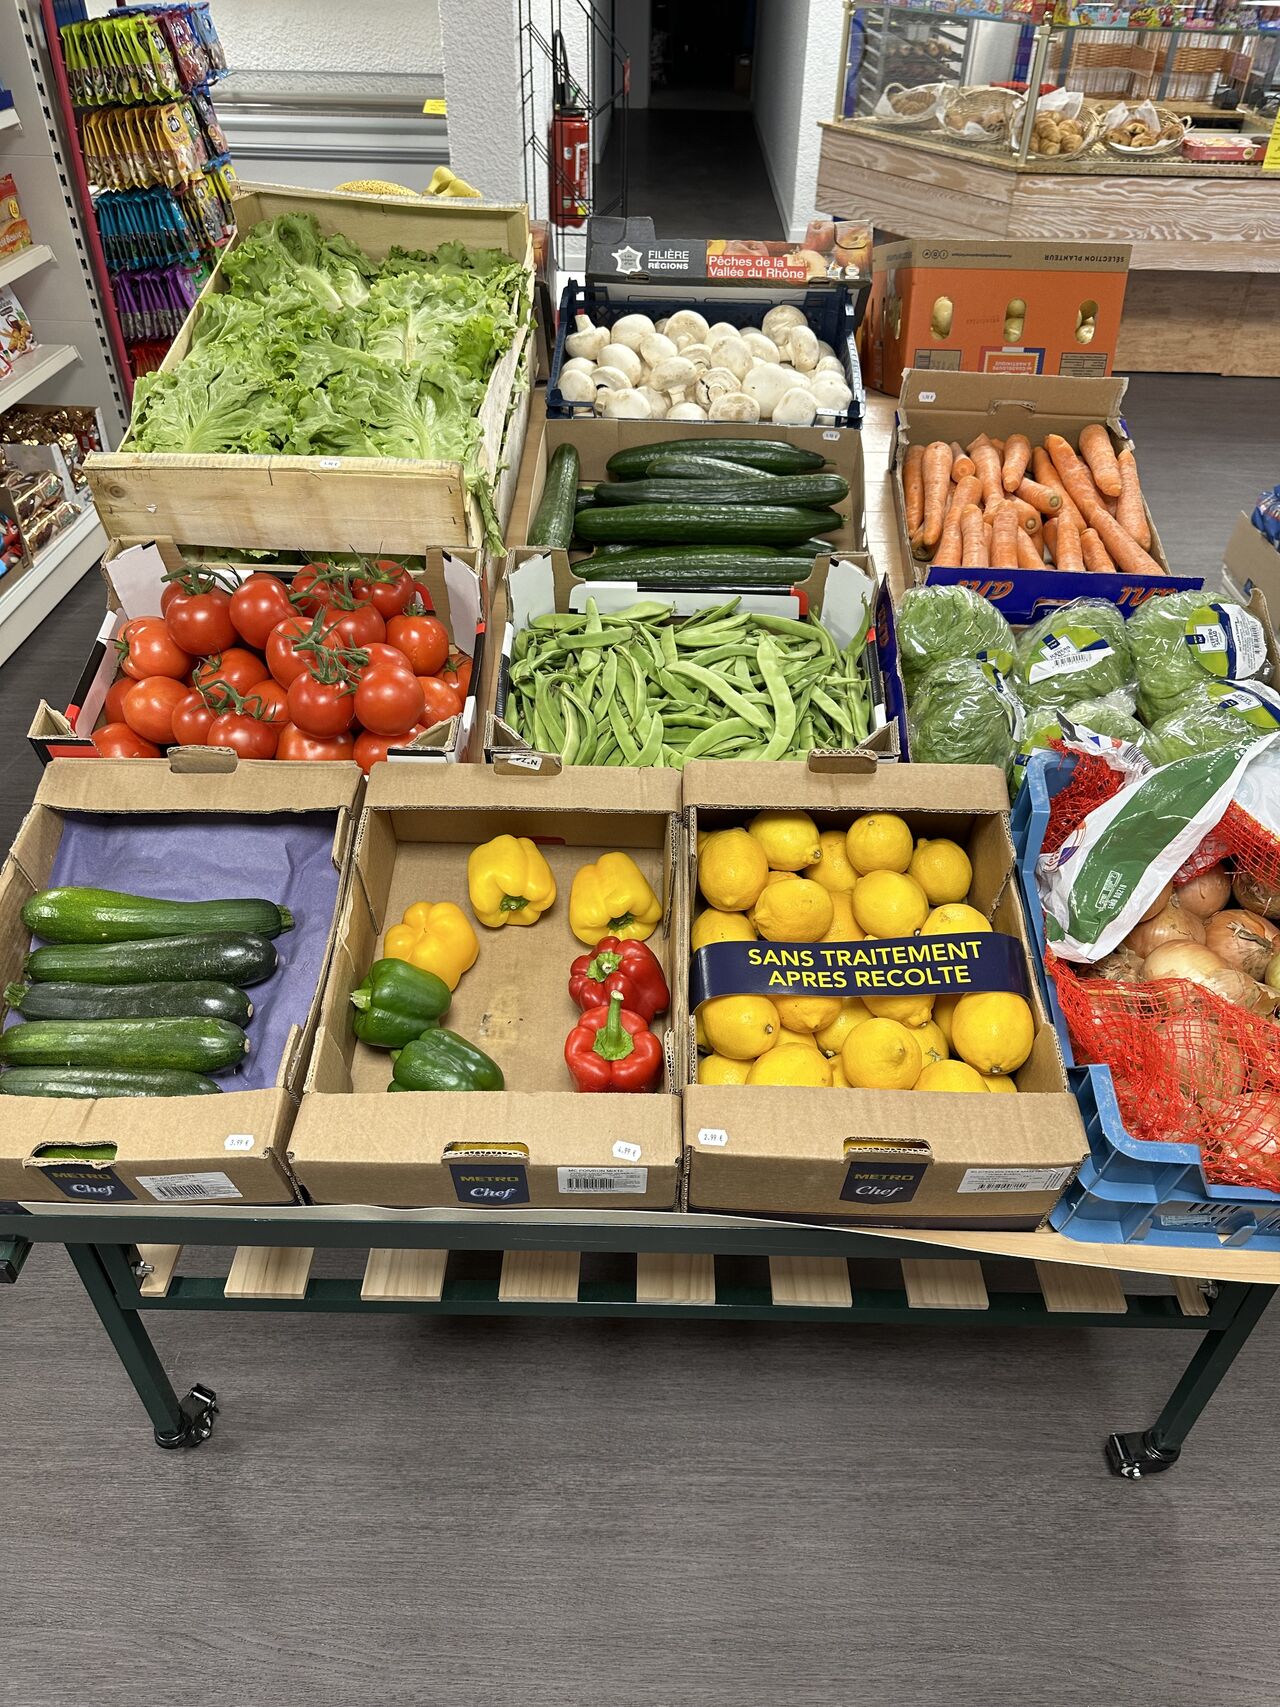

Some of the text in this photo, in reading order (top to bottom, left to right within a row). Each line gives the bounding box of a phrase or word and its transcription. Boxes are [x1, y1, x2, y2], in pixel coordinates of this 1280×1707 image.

[648, 249, 690, 260] FILIÈRE
[1044, 254, 1125, 263] SÉLECTION PLANTEUR
[648, 261, 689, 270] RÉGIONS
[709, 255, 785, 267] Pêches de la
[709, 266, 804, 278] Vallée du Rhône
[748, 940, 983, 967] SANS TRAITEMENT
[768, 965, 972, 988] APRES RECOLTE
[703, 1133, 717, 1141] 2.99
[51, 1171, 112, 1181] METRO
[853, 1173, 914, 1181] METRO
[69, 1182, 115, 1197] Chef
[469, 1187, 517, 1200] Chef
[855, 1184, 904, 1197] Chef
